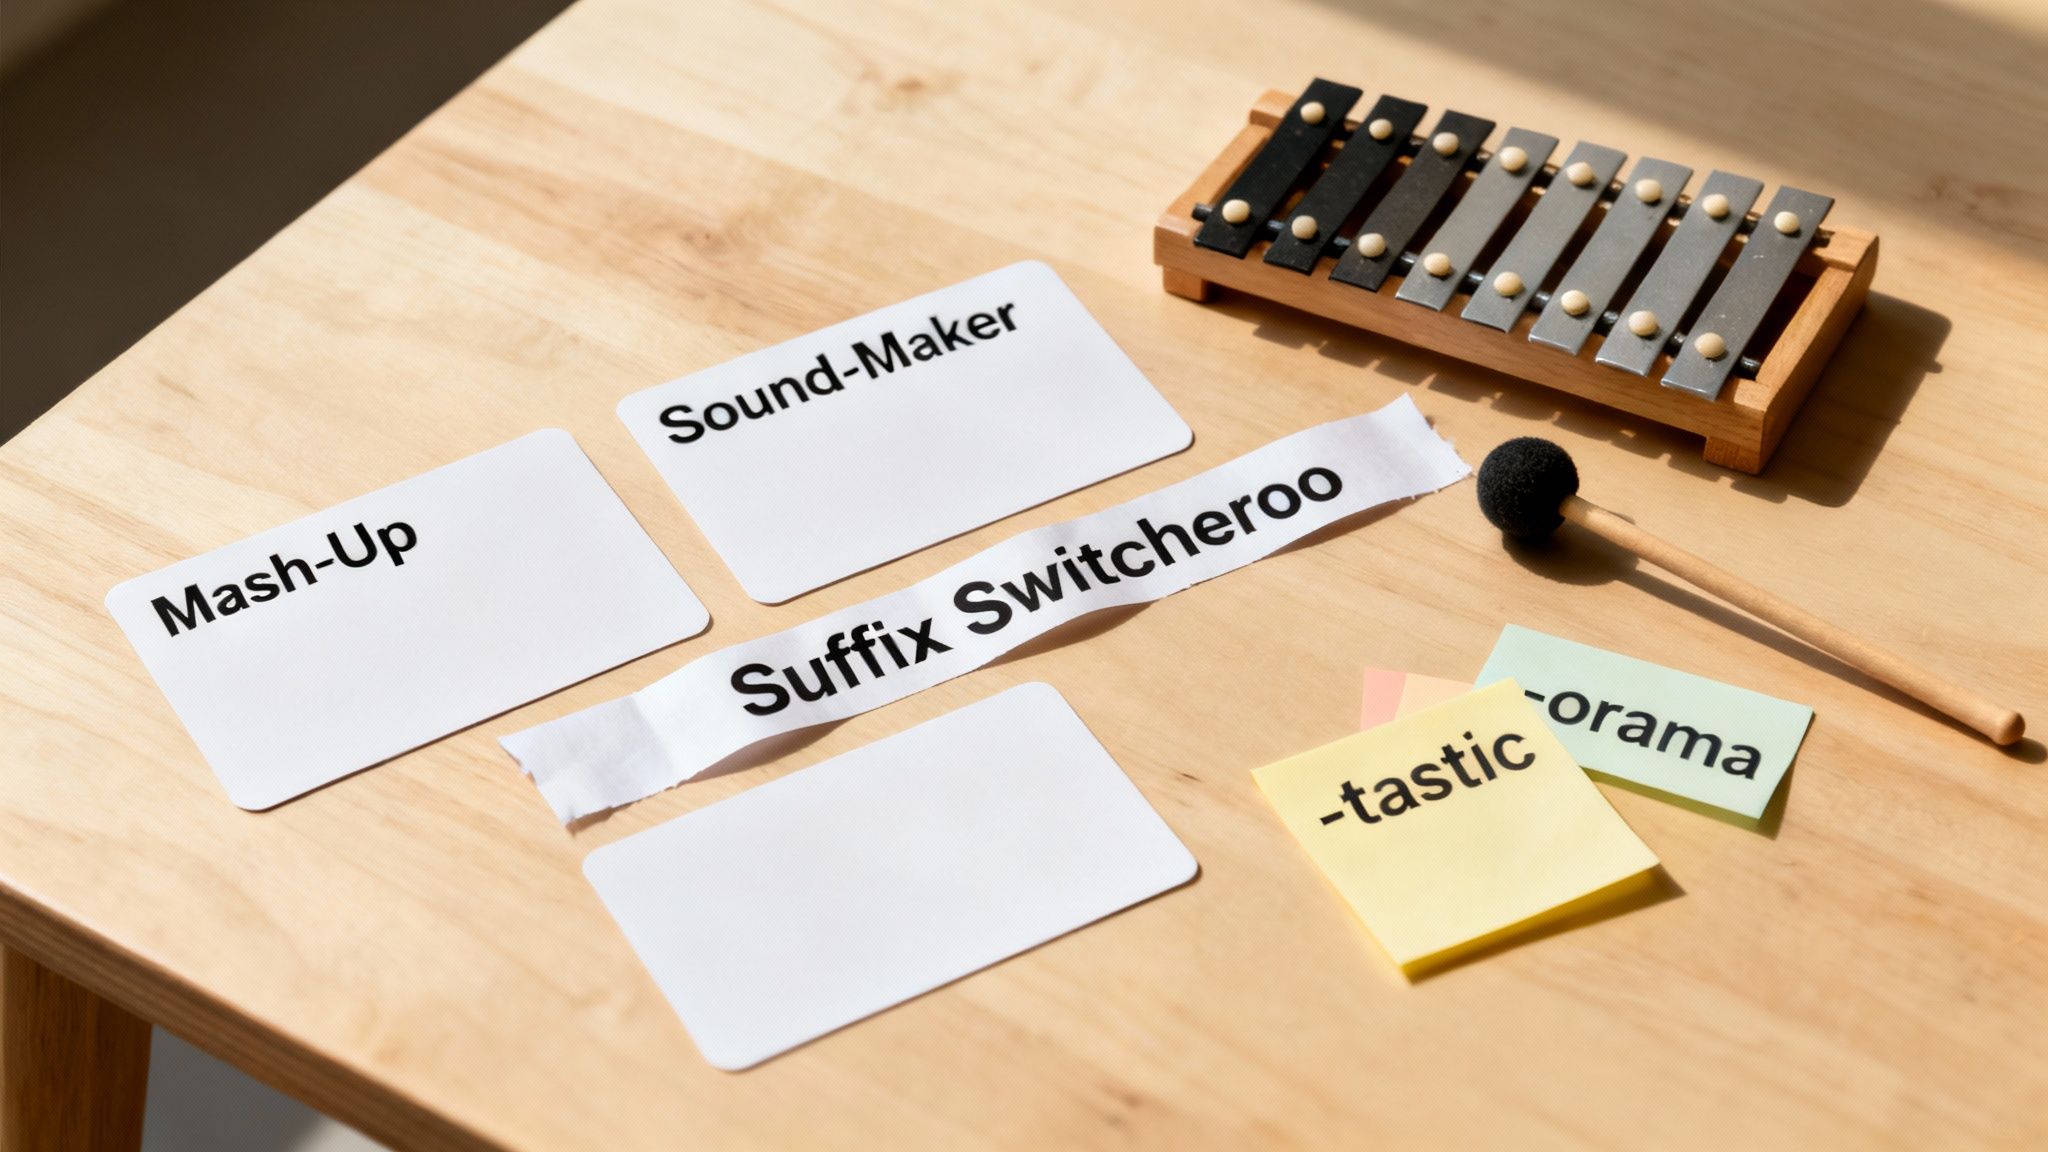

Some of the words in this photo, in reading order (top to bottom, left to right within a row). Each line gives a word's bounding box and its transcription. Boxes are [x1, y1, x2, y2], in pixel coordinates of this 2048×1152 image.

[658, 298, 1018, 445] Sound-Maker
[150, 520, 418, 639] Mash-Up
[730, 617, 953, 717] Suffix
[952, 466, 1344, 636] Switcheroo
[1319, 731, 1537, 826] -tastic
[1523, 689, 1763, 780] -orama
